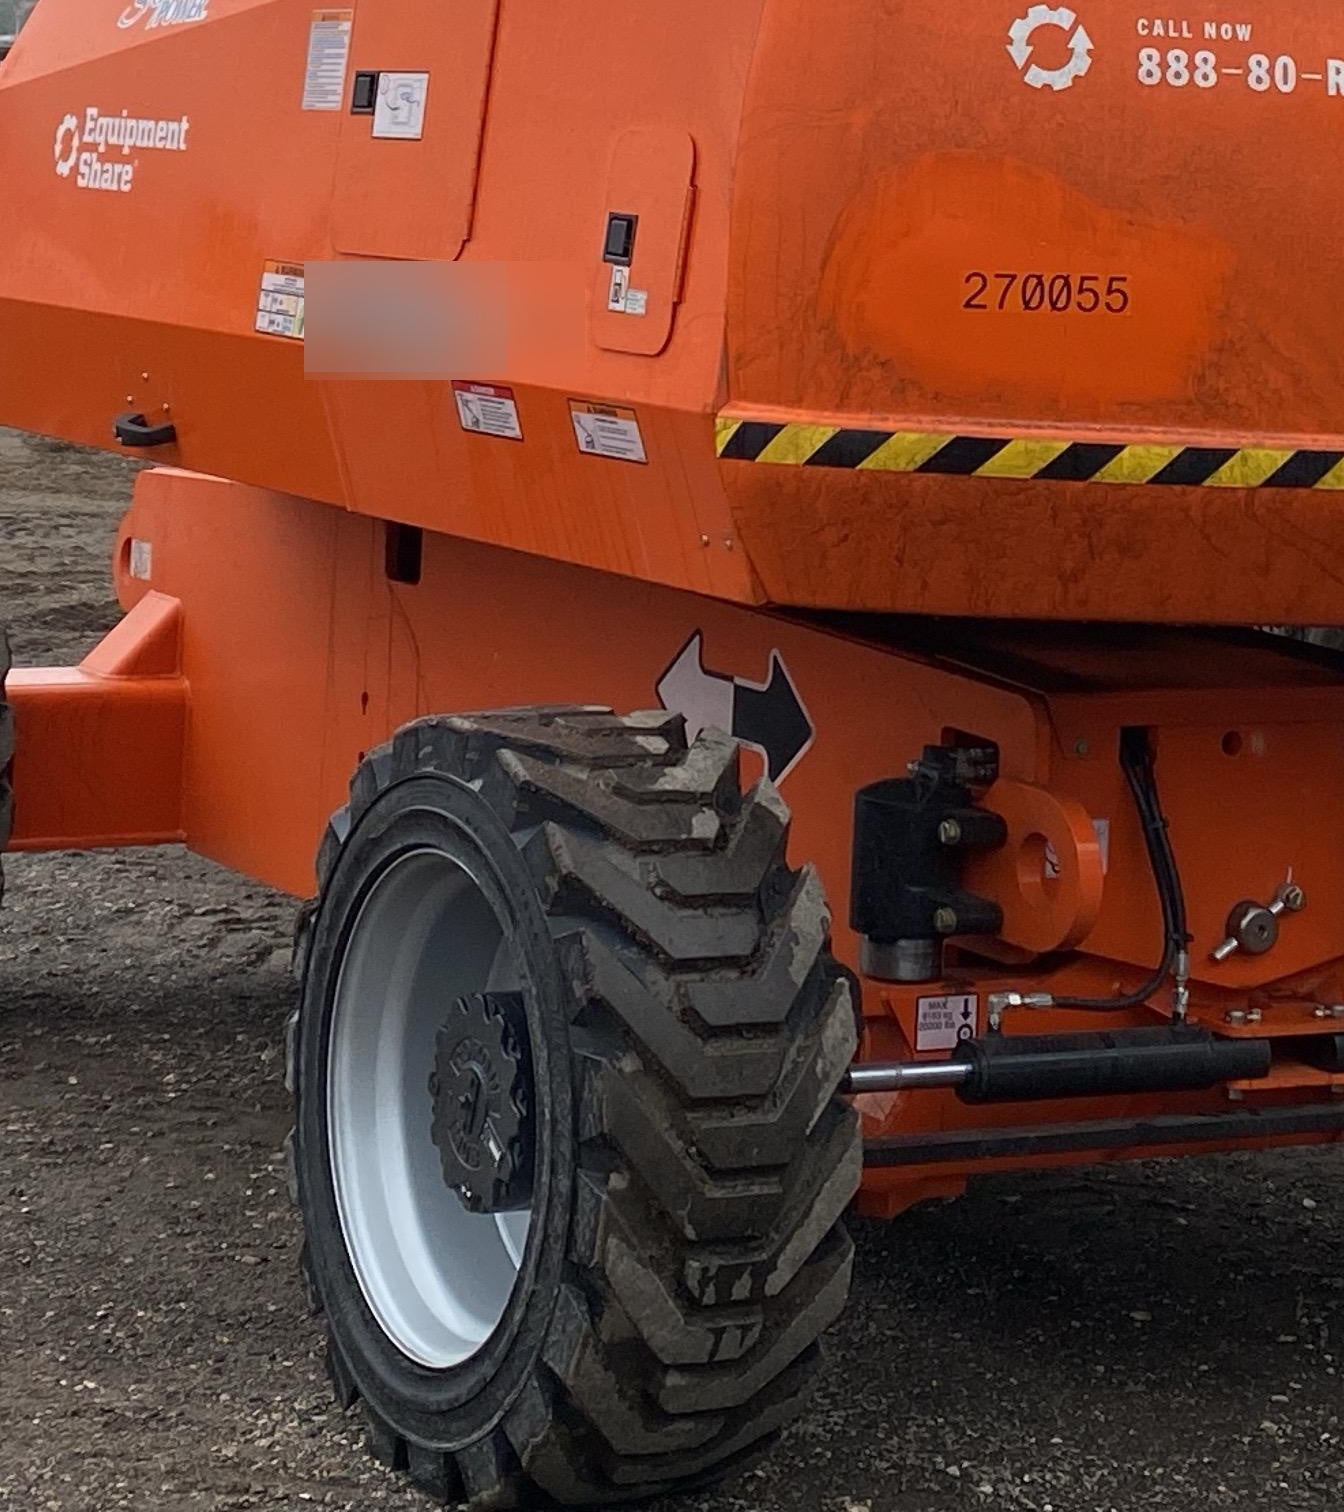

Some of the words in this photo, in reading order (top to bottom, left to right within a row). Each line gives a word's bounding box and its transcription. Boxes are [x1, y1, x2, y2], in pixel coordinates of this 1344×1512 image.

[1137, 18, 1193, 38] CALL
[1203, 22, 1252, 41] NOW
[83, 107, 189, 155] Equipment
[77, 151, 133, 193] Share
[962, 271, 1130, 314] 270055
